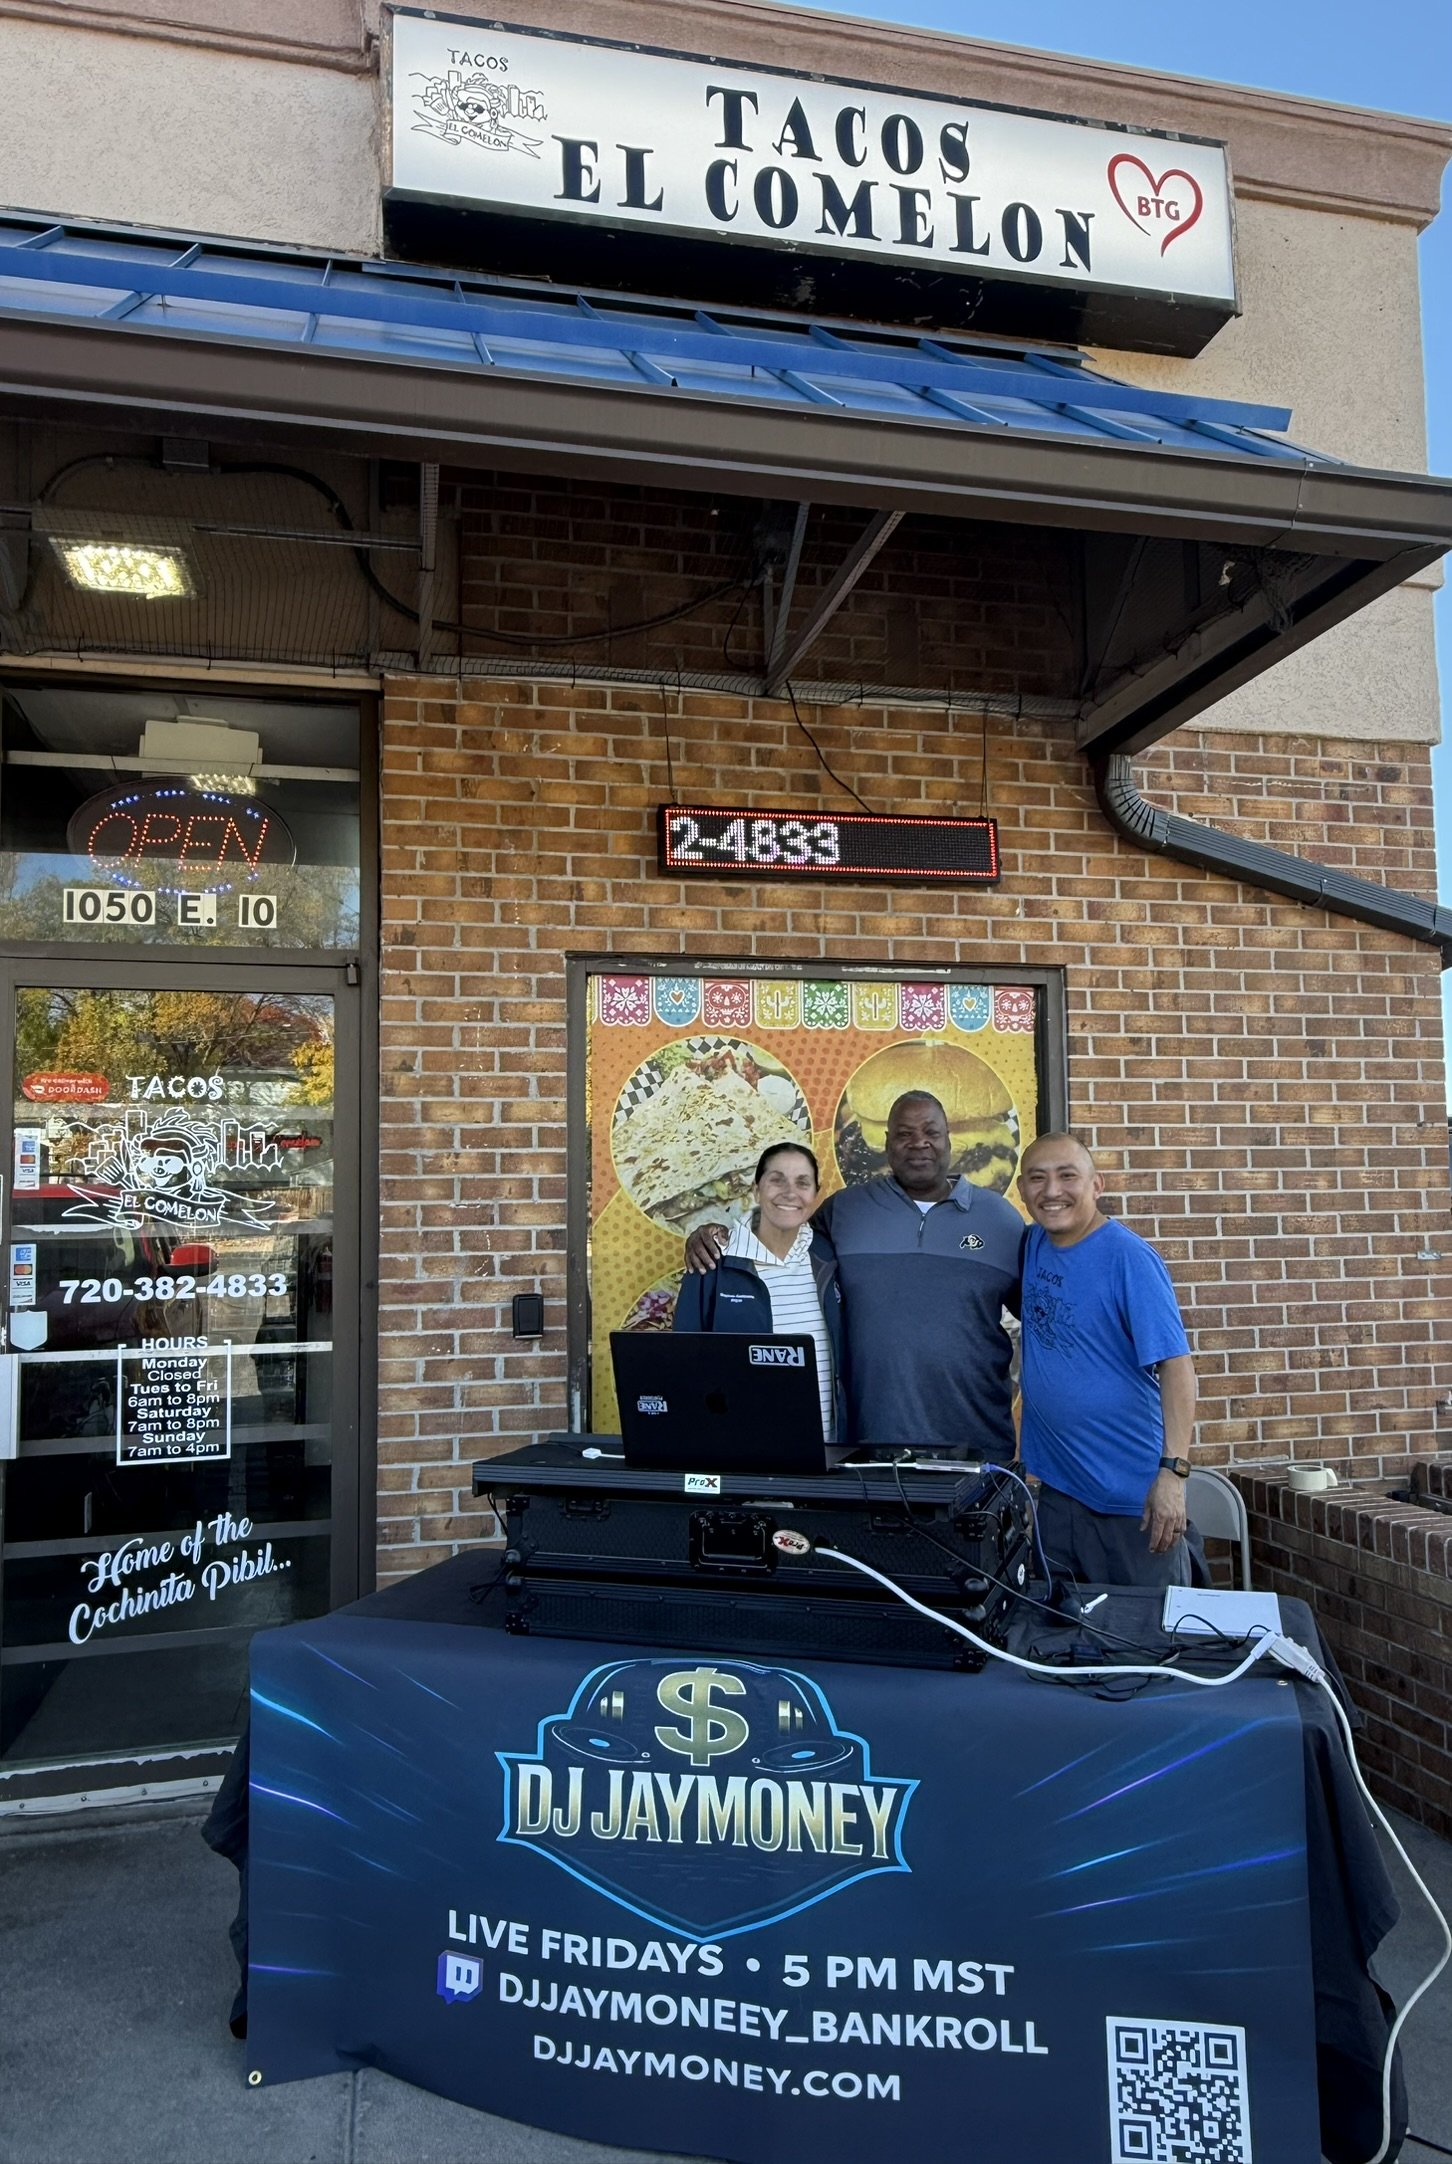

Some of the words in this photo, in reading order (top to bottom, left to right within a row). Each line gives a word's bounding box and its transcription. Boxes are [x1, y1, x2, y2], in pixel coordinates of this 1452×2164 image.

[447, 48, 509, 72] TACOS
[448, 122, 460, 133] EL
[461, 125, 508, 148] COMELON
[706, 85, 970, 184] TACOS
[552, 135, 664, 211] EL
[705, 159, 1095, 273] COMELON
[1137, 196, 1181, 221] BTG
[88, 812, 271, 872] OPEN
[669, 816, 840, 865] 2-4833
[67, 891, 153, 923] 1050
[180, 896, 215, 925] E.
[242, 897, 275, 927] 10
[126, 1074, 224, 1100] TACOS
[124, 1195, 141, 1208] EL
[144, 1196, 217, 1221] COMELON
[59, 1273, 288, 1304] 720-382-4833
[142, 1336, 208, 1351] HOURS
[751, 1346, 806, 1367] RANE
[142, 1357, 208, 1369] Monday
[147, 1370, 202, 1381] Closed
[128, 1396, 162, 1408] 6am
[167, 1395, 182, 1406] to
[186, 1393, 220, 1406] 8pm
[130, 1384, 170, 1395] Tues
[175, 1382, 191, 1393] to
[197, 1380, 218, 1391] Fri
[128, 1421, 162, 1432] 7am
[167, 1419, 182, 1430] to
[186, 1418, 220, 1430] 8pm
[137, 1406, 212, 1419] Saturday
[128, 1446, 162, 1457] 7am
[167, 1444, 182, 1455] to
[185, 1443, 220, 1455] 4pm
[143, 1431, 206, 1444] Sunday
[688, 1477, 718, 1488] ProX
[80, 1537, 175, 1593] Home
[180, 1520, 205, 1564] of
[208, 1512, 253, 1545] the
[68, 1572, 195, 1645] Cochinita
[516, 1764, 583, 1837] DJ
[590, 1768, 898, 1859] JAYMONEY
[448, 1909, 529, 1955] LIVE
[542, 1930, 724, 1977] FRIDAYS
[782, 1955, 811, 1987] 5
[828, 1956, 898, 1991] PM
[913, 1959, 1015, 1996] MST
[499, 1972, 1049, 2055] DJJAYMONEEY_BANKROLL
[533, 2034, 902, 2101] DJJAYMONEY.COM
